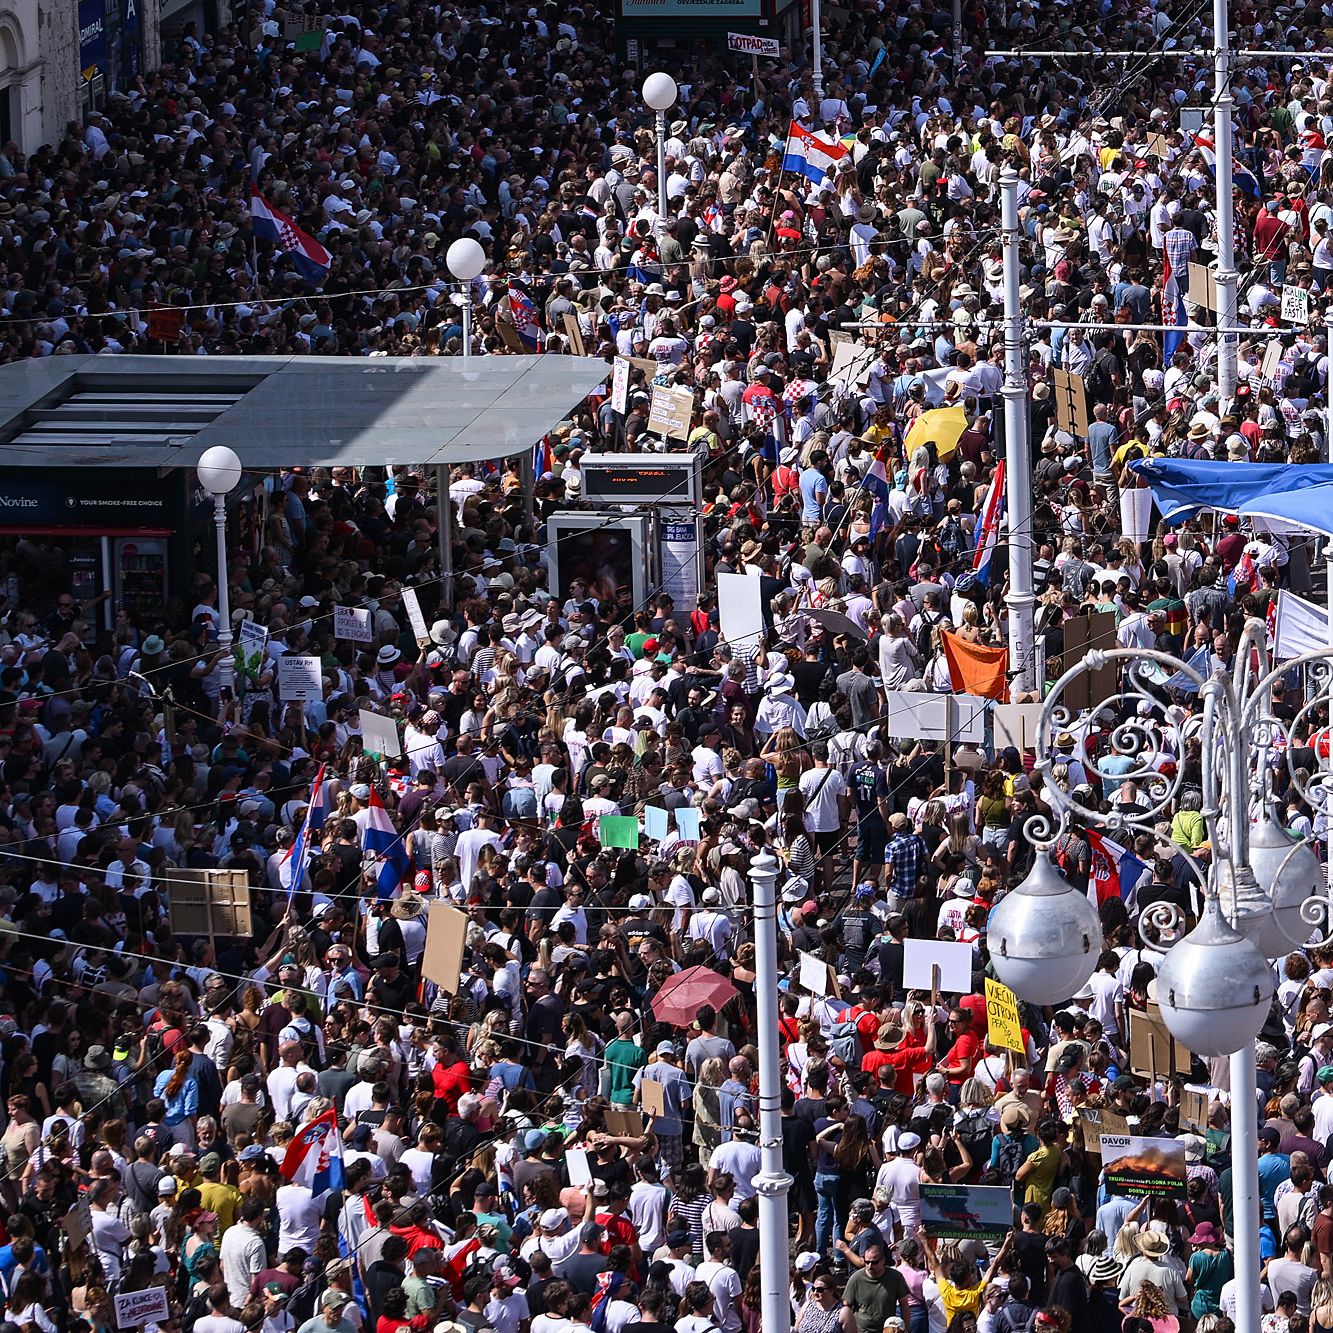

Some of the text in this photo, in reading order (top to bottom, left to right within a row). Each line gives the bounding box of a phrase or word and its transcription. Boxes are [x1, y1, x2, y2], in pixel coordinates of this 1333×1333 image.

[0, 496, 38, 508] Novine
[138, 499, 162, 507] CHOICE
[666, 525, 675, 534] TRG
[284, 659, 313, 667] USTAV RH
[1079, 1109, 1102, 1124] HDZ
[1101, 1137, 1131, 1147] DAVOR
[923, 1187, 957, 1196] DAVOR
